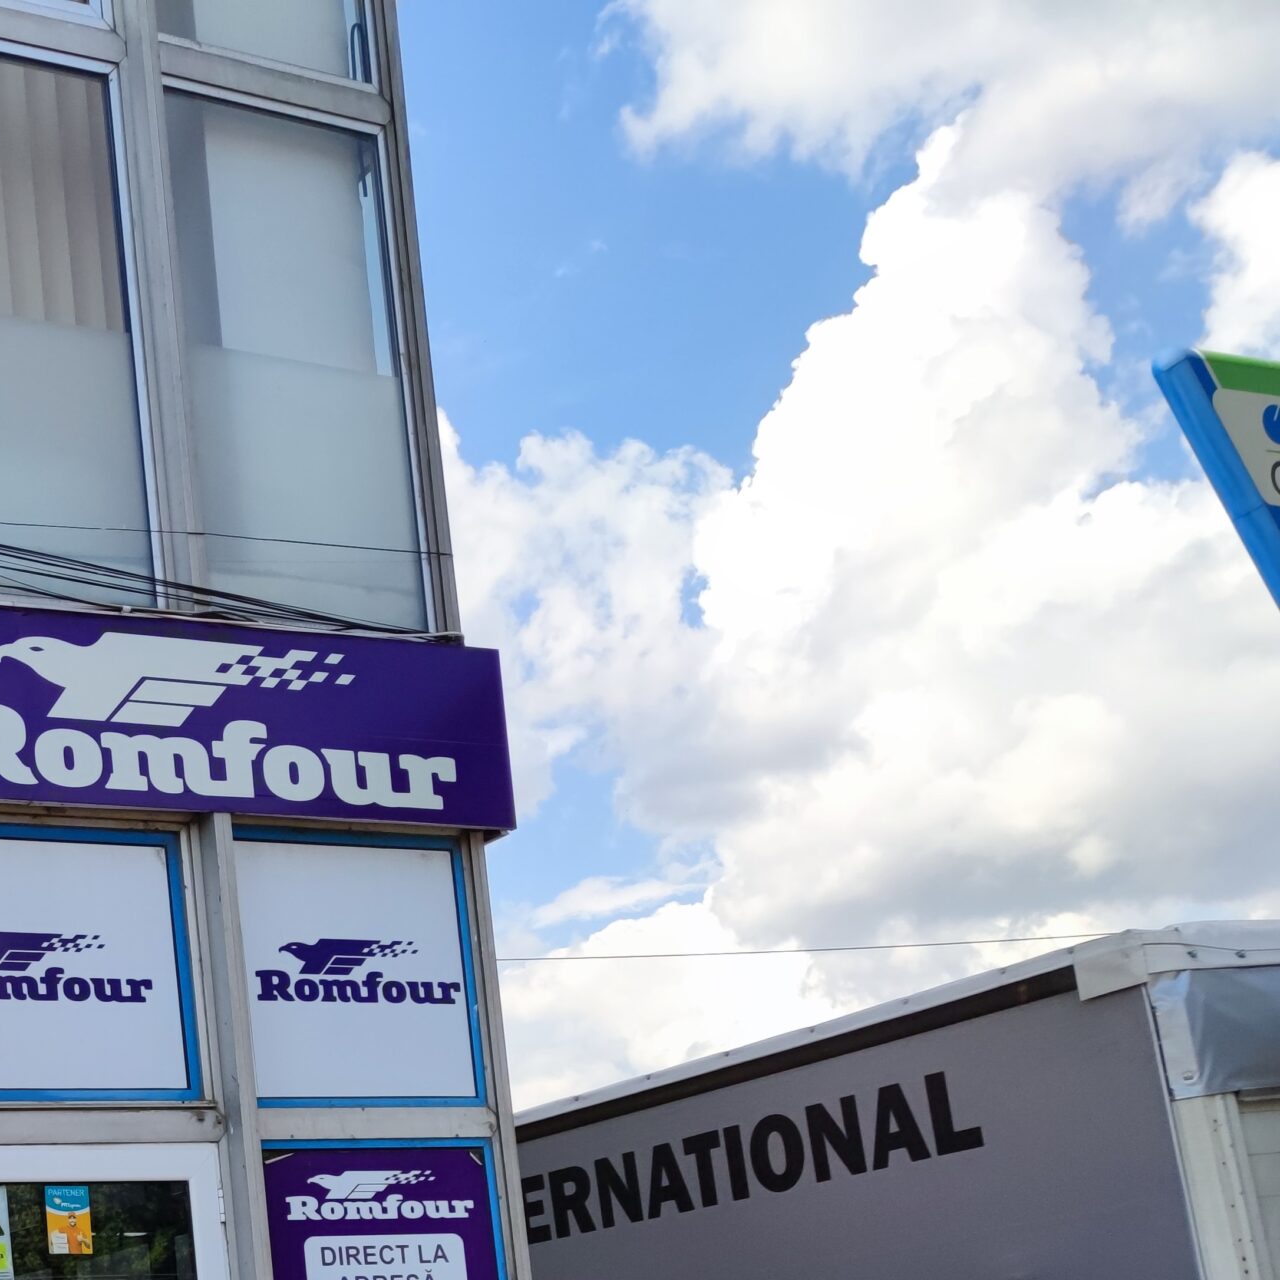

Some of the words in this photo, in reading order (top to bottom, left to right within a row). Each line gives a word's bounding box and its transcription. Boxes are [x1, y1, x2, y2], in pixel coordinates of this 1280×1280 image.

[255, 969, 460, 1004] Romfour
[521, 1071, 985, 1244] ERNATIONAL
[286, 1194, 474, 1221] Romfour
[320, 1244, 410, 1267] DIRECT
[417, 1243, 449, 1264] LA
